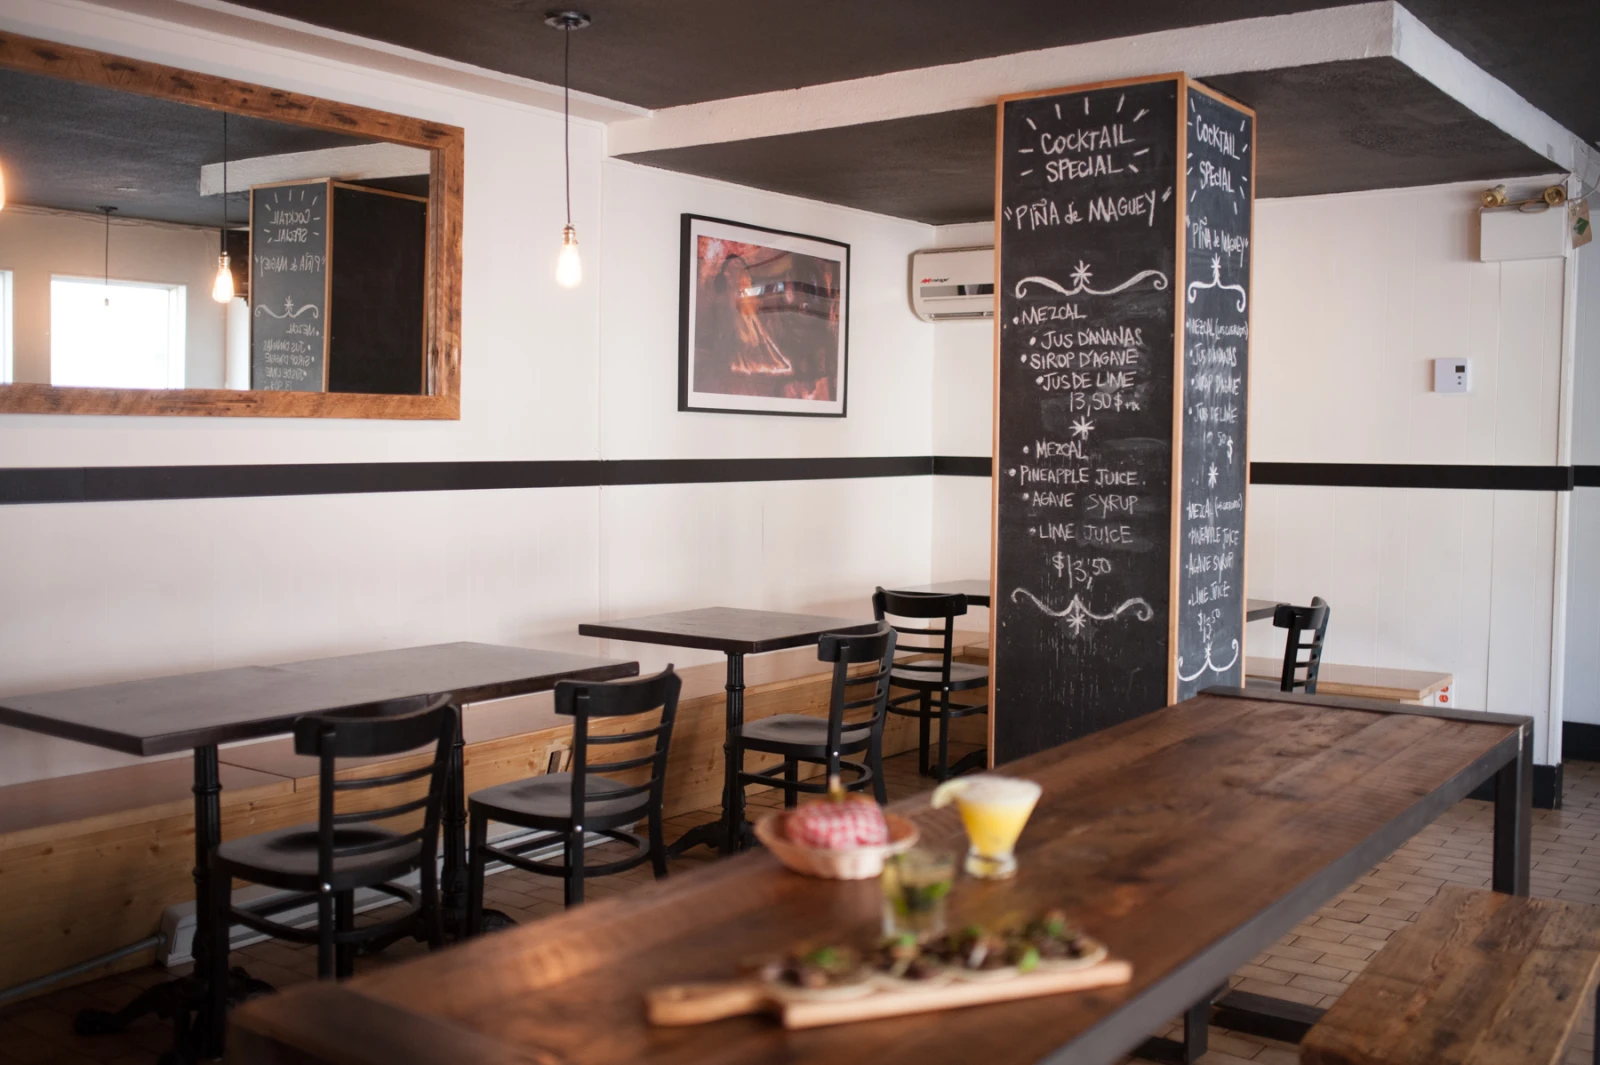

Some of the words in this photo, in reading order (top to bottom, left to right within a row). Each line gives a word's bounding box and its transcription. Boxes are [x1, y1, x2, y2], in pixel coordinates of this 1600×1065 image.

[1041, 123, 1136, 155] COCKTAIL
[1196, 115, 1240, 160] COCKTAIL
[1045, 154, 1124, 182] SPECIAL
[1200, 160, 1235, 193] SPECIAL
[1064, 202, 1084, 224] de
[1022, 303, 1087, 325] MEZCAL
[1041, 331, 1073, 350] JUS
[1078, 326, 1143, 347] D'ANANAS
[1030, 352, 1075, 369] SIROP
[1079, 349, 1139, 368] D'AGAVE
[1072, 373, 1092, 389] DE
[1096, 371, 1137, 388] LIME
[1036, 438, 1088, 460] MEZCAL
[1020, 465, 1090, 486] PINEAPPLE
[1095, 468, 1139, 486] JUICE
[1032, 491, 1076, 507] AGAVE
[1087, 493, 1138, 519] SYRUP
[1039, 523, 1075, 541] LIME
[1083, 524, 1133, 544] JUICE
